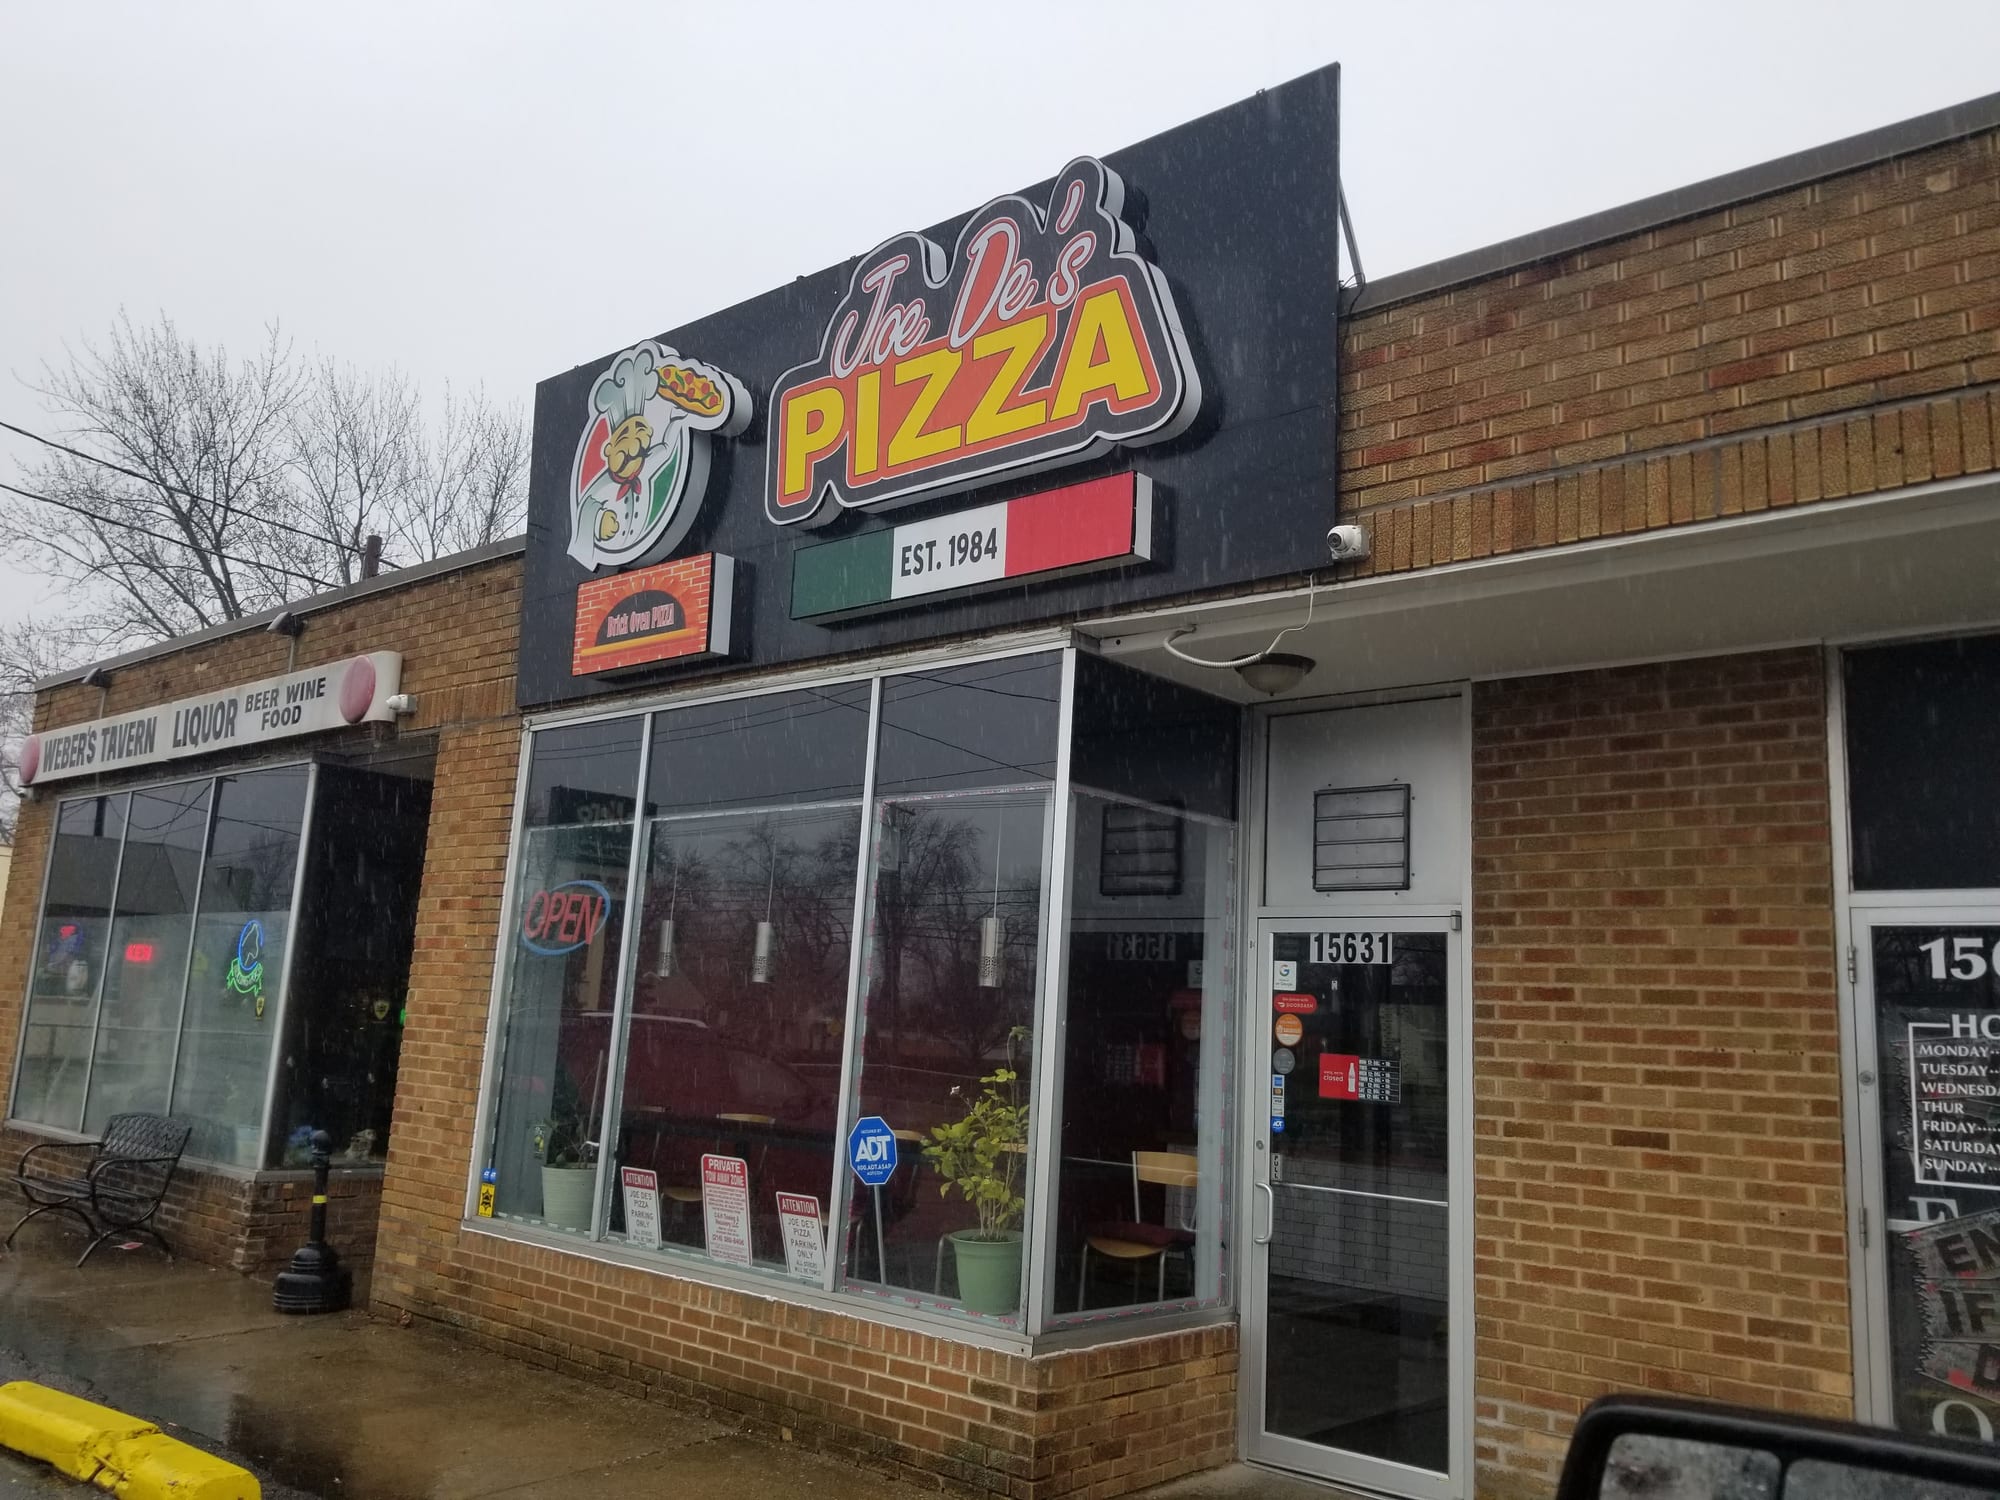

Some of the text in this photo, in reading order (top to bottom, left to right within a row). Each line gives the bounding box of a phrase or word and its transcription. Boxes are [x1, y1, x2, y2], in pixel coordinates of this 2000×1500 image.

[830, 179, 1097, 378] Joe De's
[783, 288, 1150, 497] PIZZA
[901, 527, 998, 577] EST. 1984
[606, 613, 629, 638] Brick
[629, 610, 650, 633] Oven
[244, 676, 327, 714] BEER WINE
[260, 704, 302, 732] FOOD
[42, 697, 239, 773] WEBER'S TAVERN LIQUOR
[524, 889, 604, 944] OPEN
[1312, 932, 1390, 963] 15631
[1918, 937, 2000, 981] 15
[1919, 1044, 1989, 1058] MONDAY
[1920, 1062, 1988, 1077] TUESDAY
[1921, 1100, 1965, 1115] THUR
[1922, 1119, 1977, 1134] FRIDAY
[855, 1135, 891, 1162] ADT
[708, 1159, 741, 1174] PRIVATE
[1924, 1158, 1988, 1174] SUNDAY
[625, 1172, 654, 1187] ATTENTION
[633, 1199, 649, 1209] PIZZA
[782, 1198, 816, 1214] ATTENTION
[631, 1209, 654, 1220] PARKING
[636, 1219, 650, 1228] ONLY
[788, 1218, 800, 1227] JOE
[793, 1228, 811, 1238] PIZZA
[790, 1238, 818, 1251] PARKING
[796, 1249, 814, 1259] ONLY
